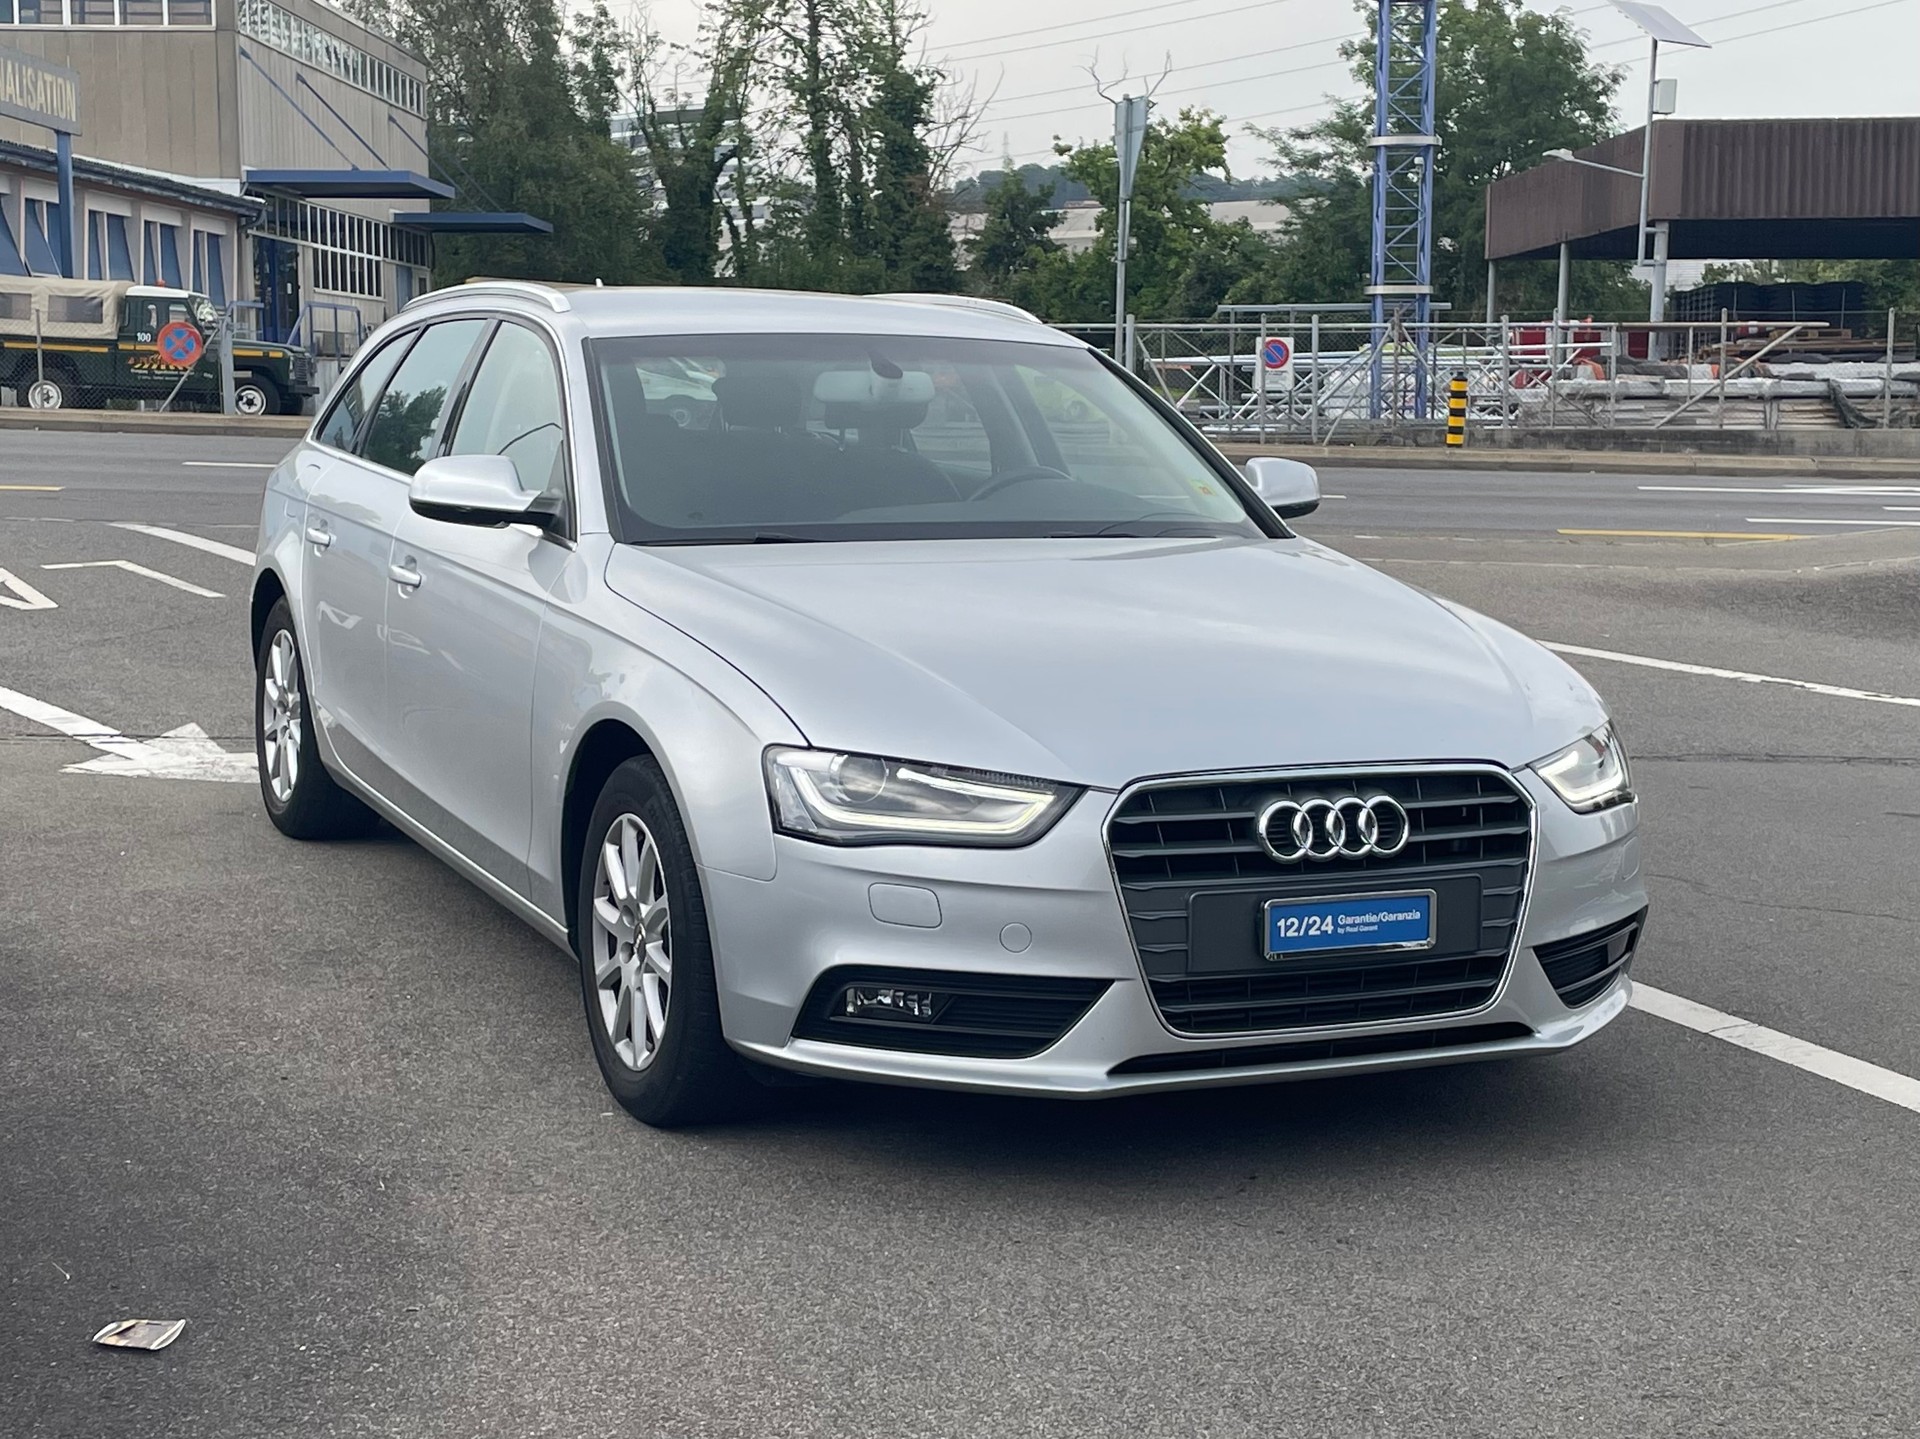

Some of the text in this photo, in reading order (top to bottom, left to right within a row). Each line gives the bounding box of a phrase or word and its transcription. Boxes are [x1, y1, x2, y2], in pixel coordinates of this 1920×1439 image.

[136, 332, 151, 343] 100
[1276, 908, 1421, 938] 12/24 Garantie/Garanzia
[1337, 926, 1345, 934] by
